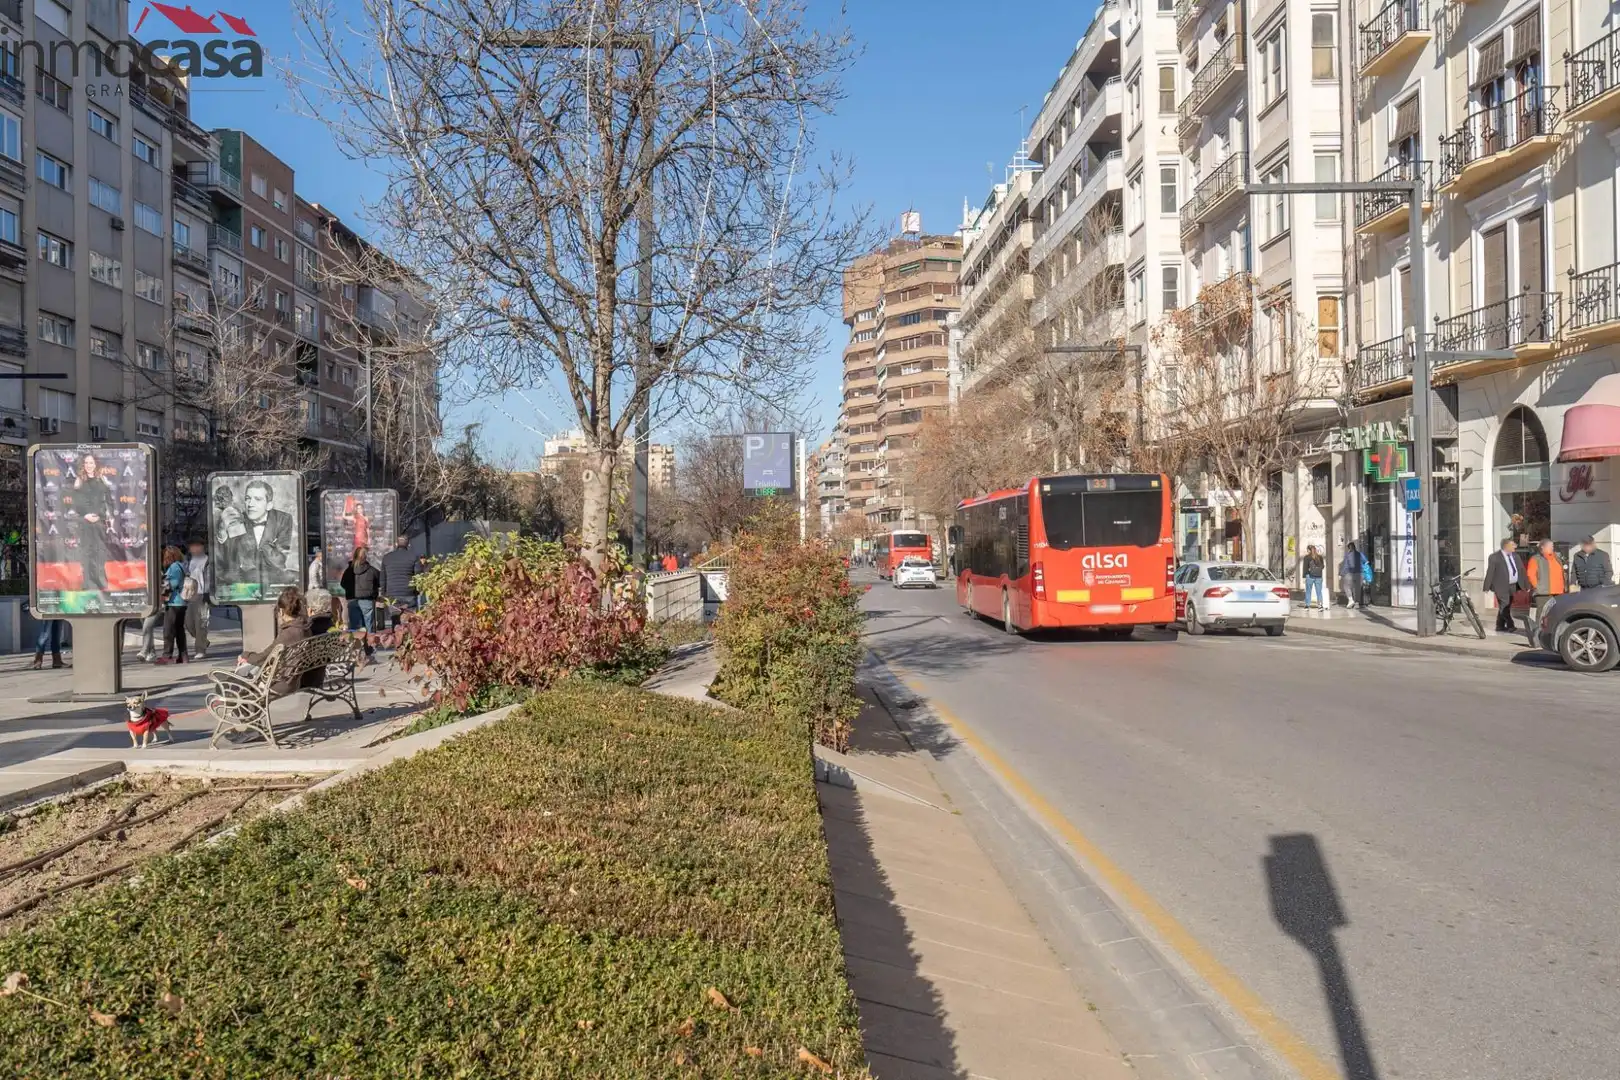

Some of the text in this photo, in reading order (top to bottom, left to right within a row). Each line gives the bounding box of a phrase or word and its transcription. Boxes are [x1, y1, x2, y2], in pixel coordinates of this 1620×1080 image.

[746, 436, 765, 459] P
[1093, 479, 1107, 489] 33
[1406, 490, 1420, 501] TAXI
[1081, 552, 1128, 569] alsa
